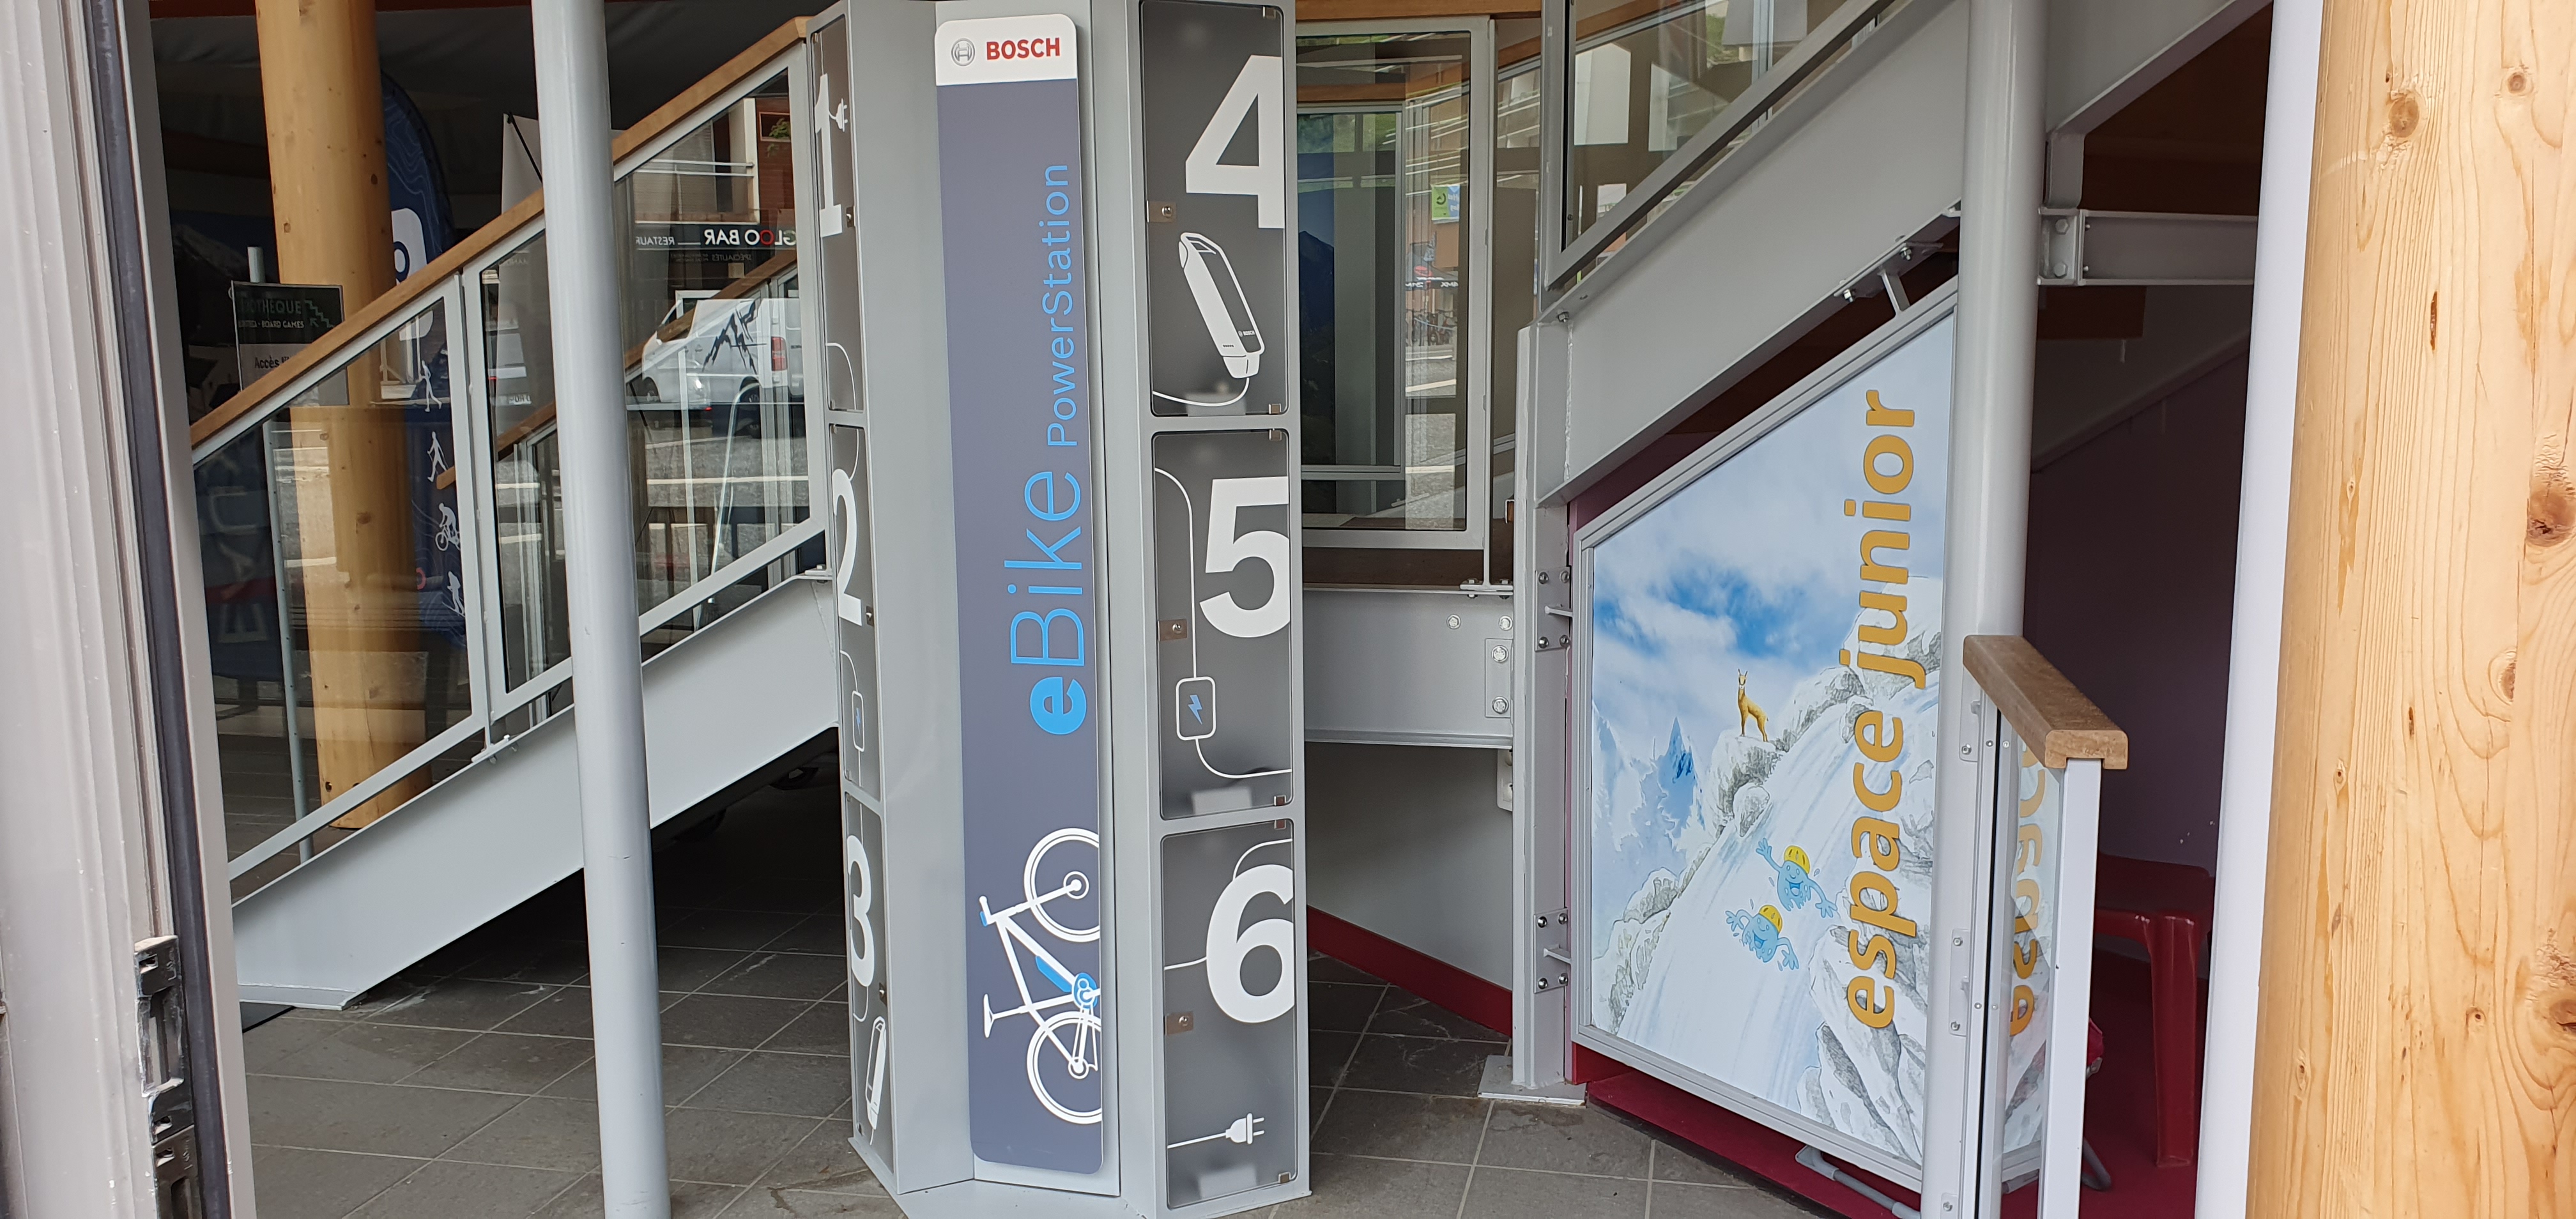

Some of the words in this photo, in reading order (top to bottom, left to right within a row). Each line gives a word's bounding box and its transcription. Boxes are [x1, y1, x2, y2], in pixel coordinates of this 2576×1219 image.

[986, 37, 1061, 61] BOSCH
[814, 73, 842, 237] 1
[1186, 54, 1285, 229] 4
[254, 355, 280, 369] Accès
[1038, 165, 1078, 446] PowerStation
[831, 468, 862, 627] 2
[1004, 471, 1087, 735] eBike
[1199, 476, 1291, 638] 5
[1839, 390, 1926, 689] junior
[847, 835, 875, 987] 3
[1206, 864, 1295, 1023] 6
[1846, 710, 1917, 1029] espace
